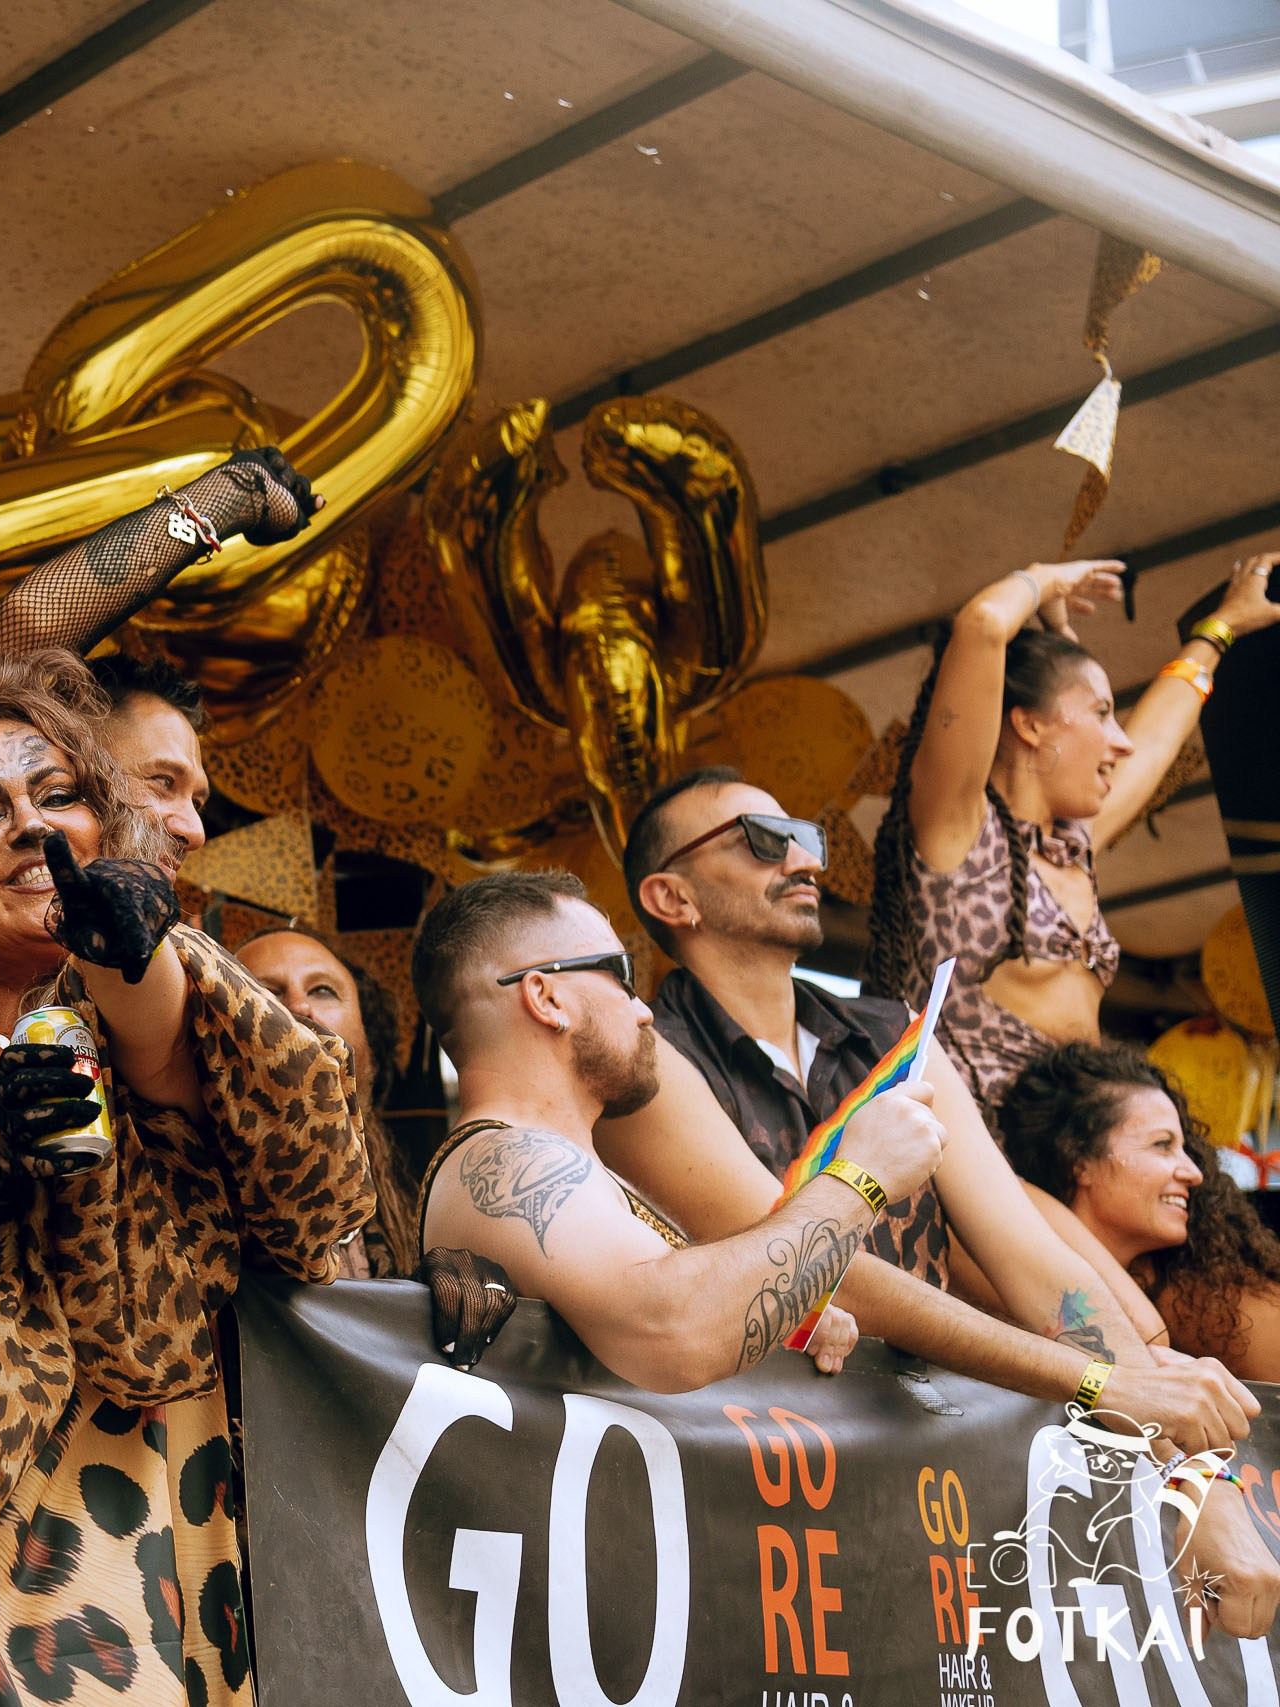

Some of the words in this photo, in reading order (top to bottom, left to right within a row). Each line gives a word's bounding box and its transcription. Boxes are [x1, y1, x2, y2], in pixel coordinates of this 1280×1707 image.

[723, 1406, 837, 1510] GO
[918, 1466, 969, 1546] GO
[365, 1362, 690, 1707] GO
[757, 1525, 850, 1676] RE
[930, 1555, 984, 1645] RE
[938, 1653, 978, 1689] HAIR
[981, 1654, 992, 1690] &
